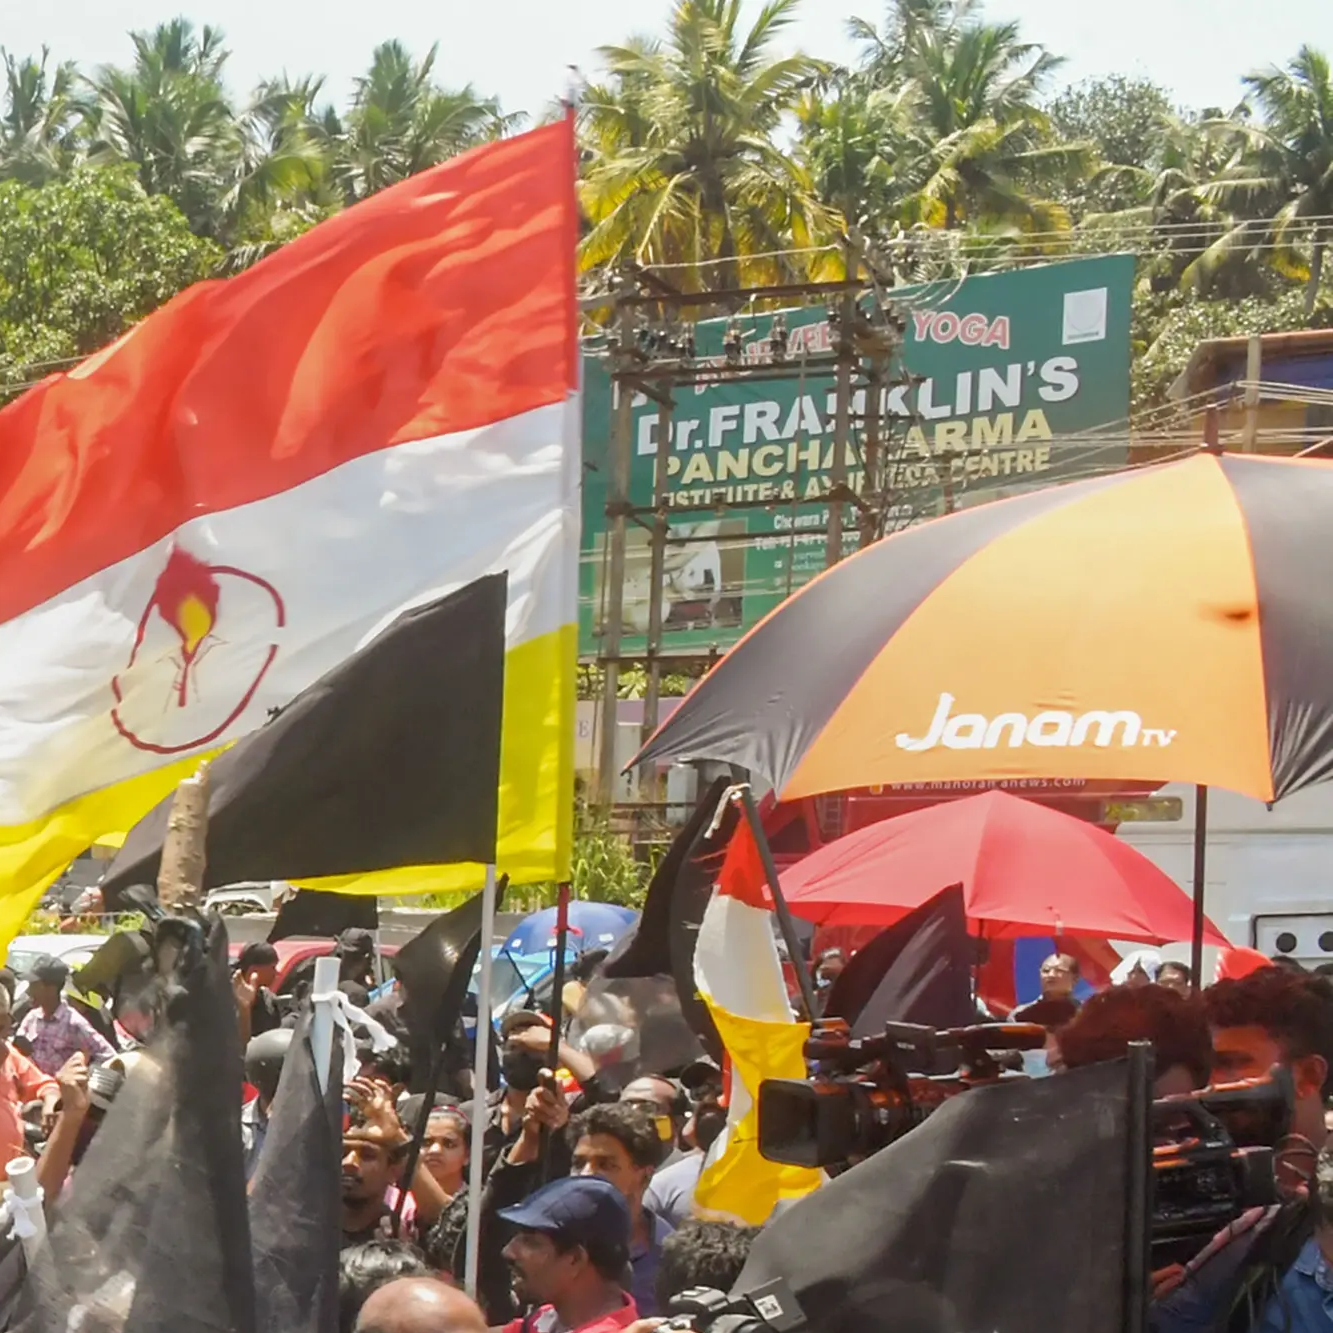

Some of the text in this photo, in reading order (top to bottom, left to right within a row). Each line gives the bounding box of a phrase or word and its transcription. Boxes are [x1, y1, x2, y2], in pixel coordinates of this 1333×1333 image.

[912, 311, 1010, 349] YOGA
[895, 692, 1177, 751] Janam TV
